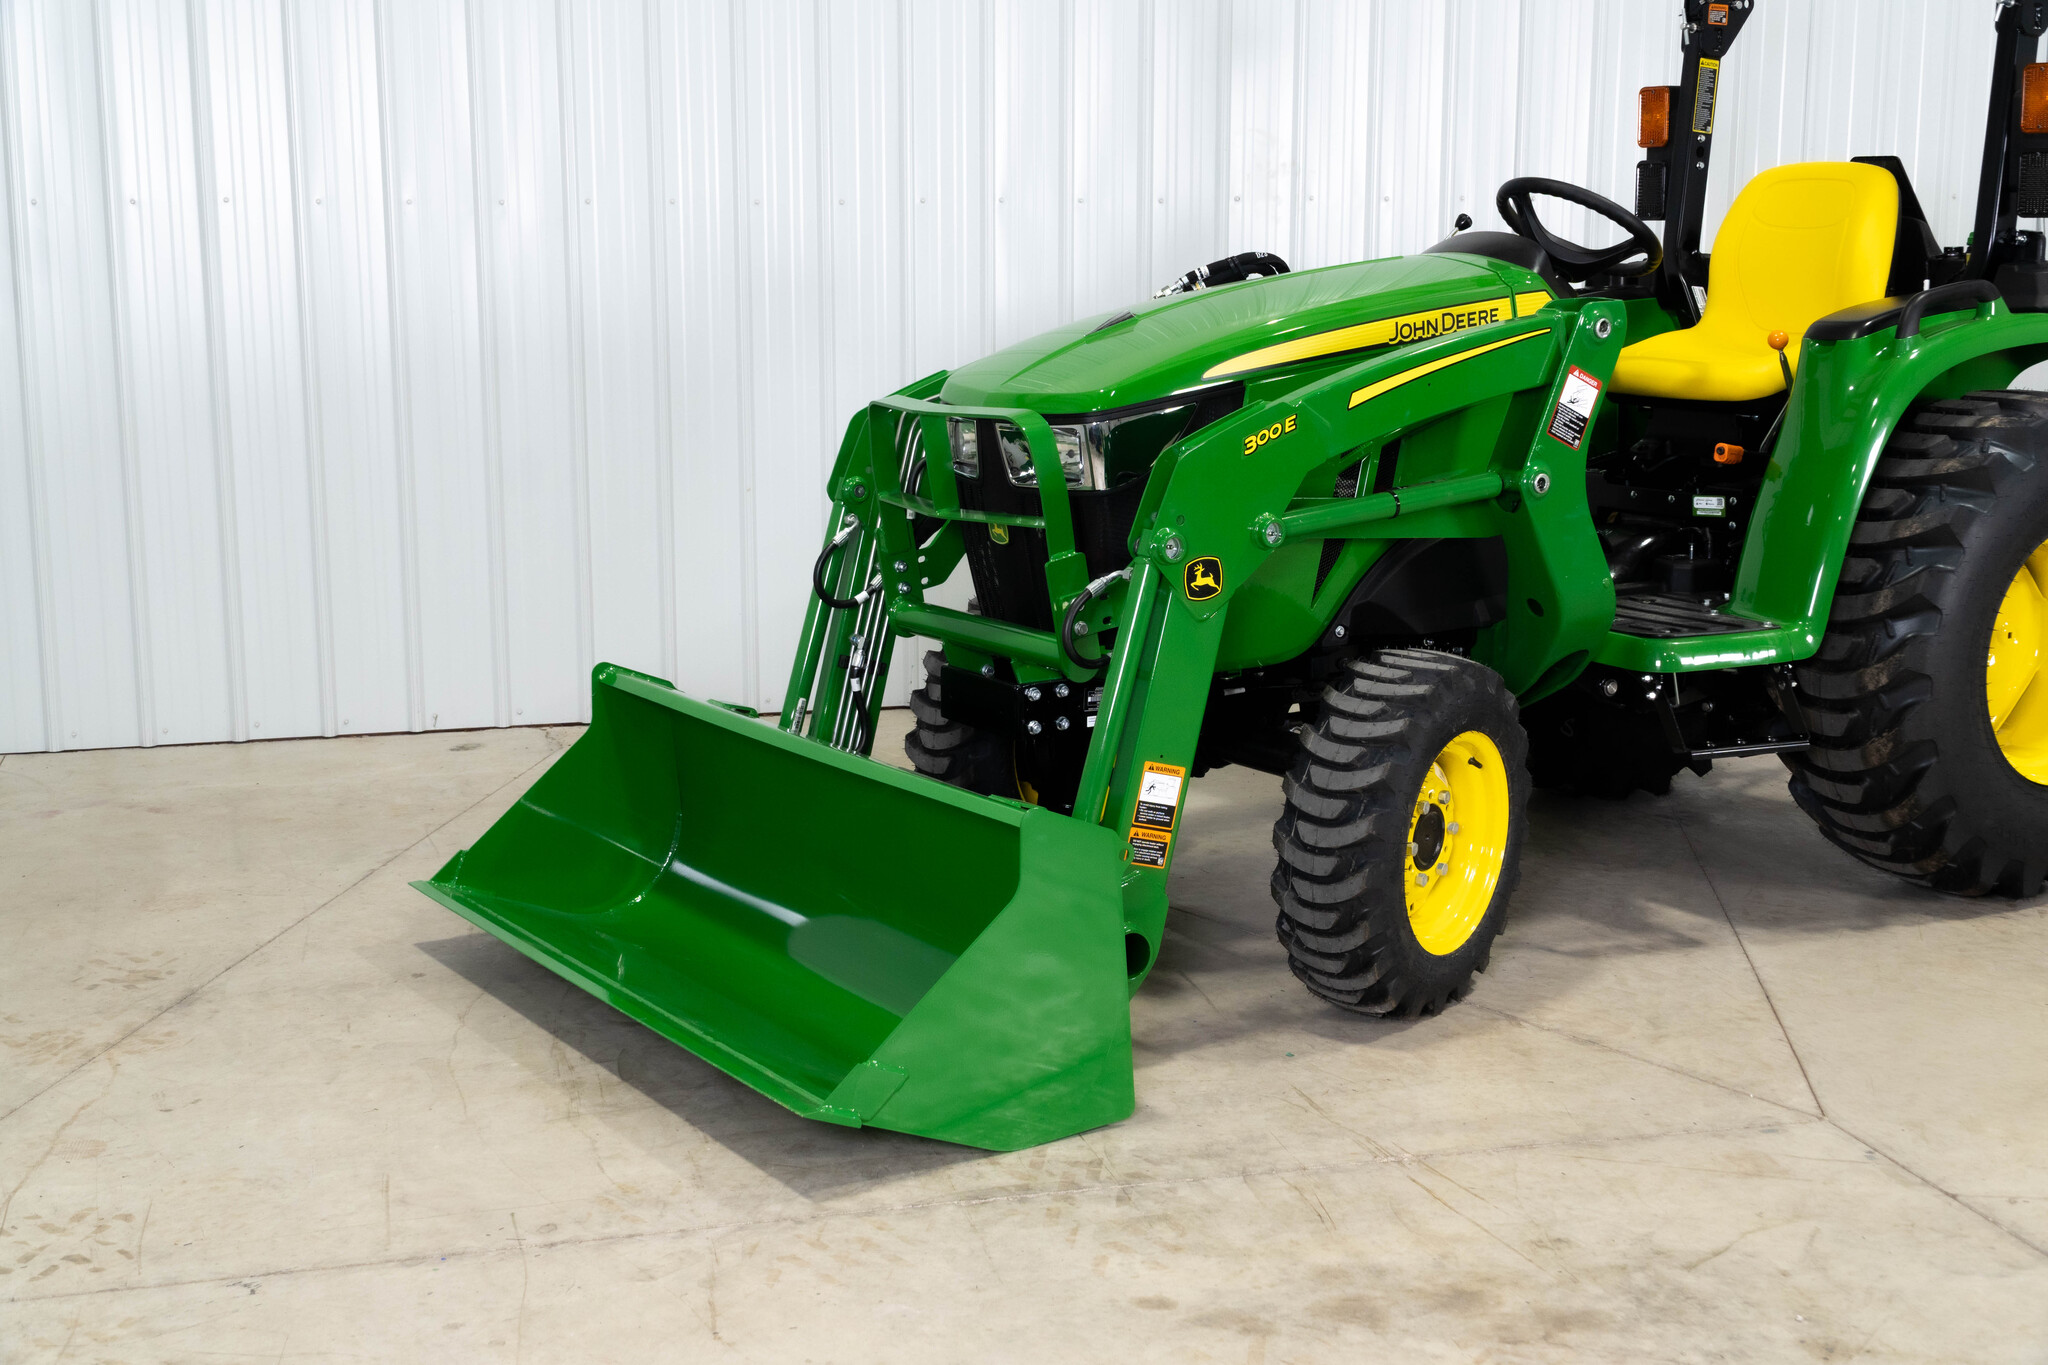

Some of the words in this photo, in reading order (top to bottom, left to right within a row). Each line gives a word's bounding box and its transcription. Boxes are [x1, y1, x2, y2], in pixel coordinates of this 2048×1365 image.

[1388, 318, 1439, 342] JOHN
[1442, 308, 1499, 332] DEERE
[1579, 373, 1598, 387] DANGER
[1244, 423, 1283, 456] 300
[1285, 413, 1298, 435] E
[1155, 766, 1180, 775] WARNING
[1141, 831, 1167, 841] WARNING
